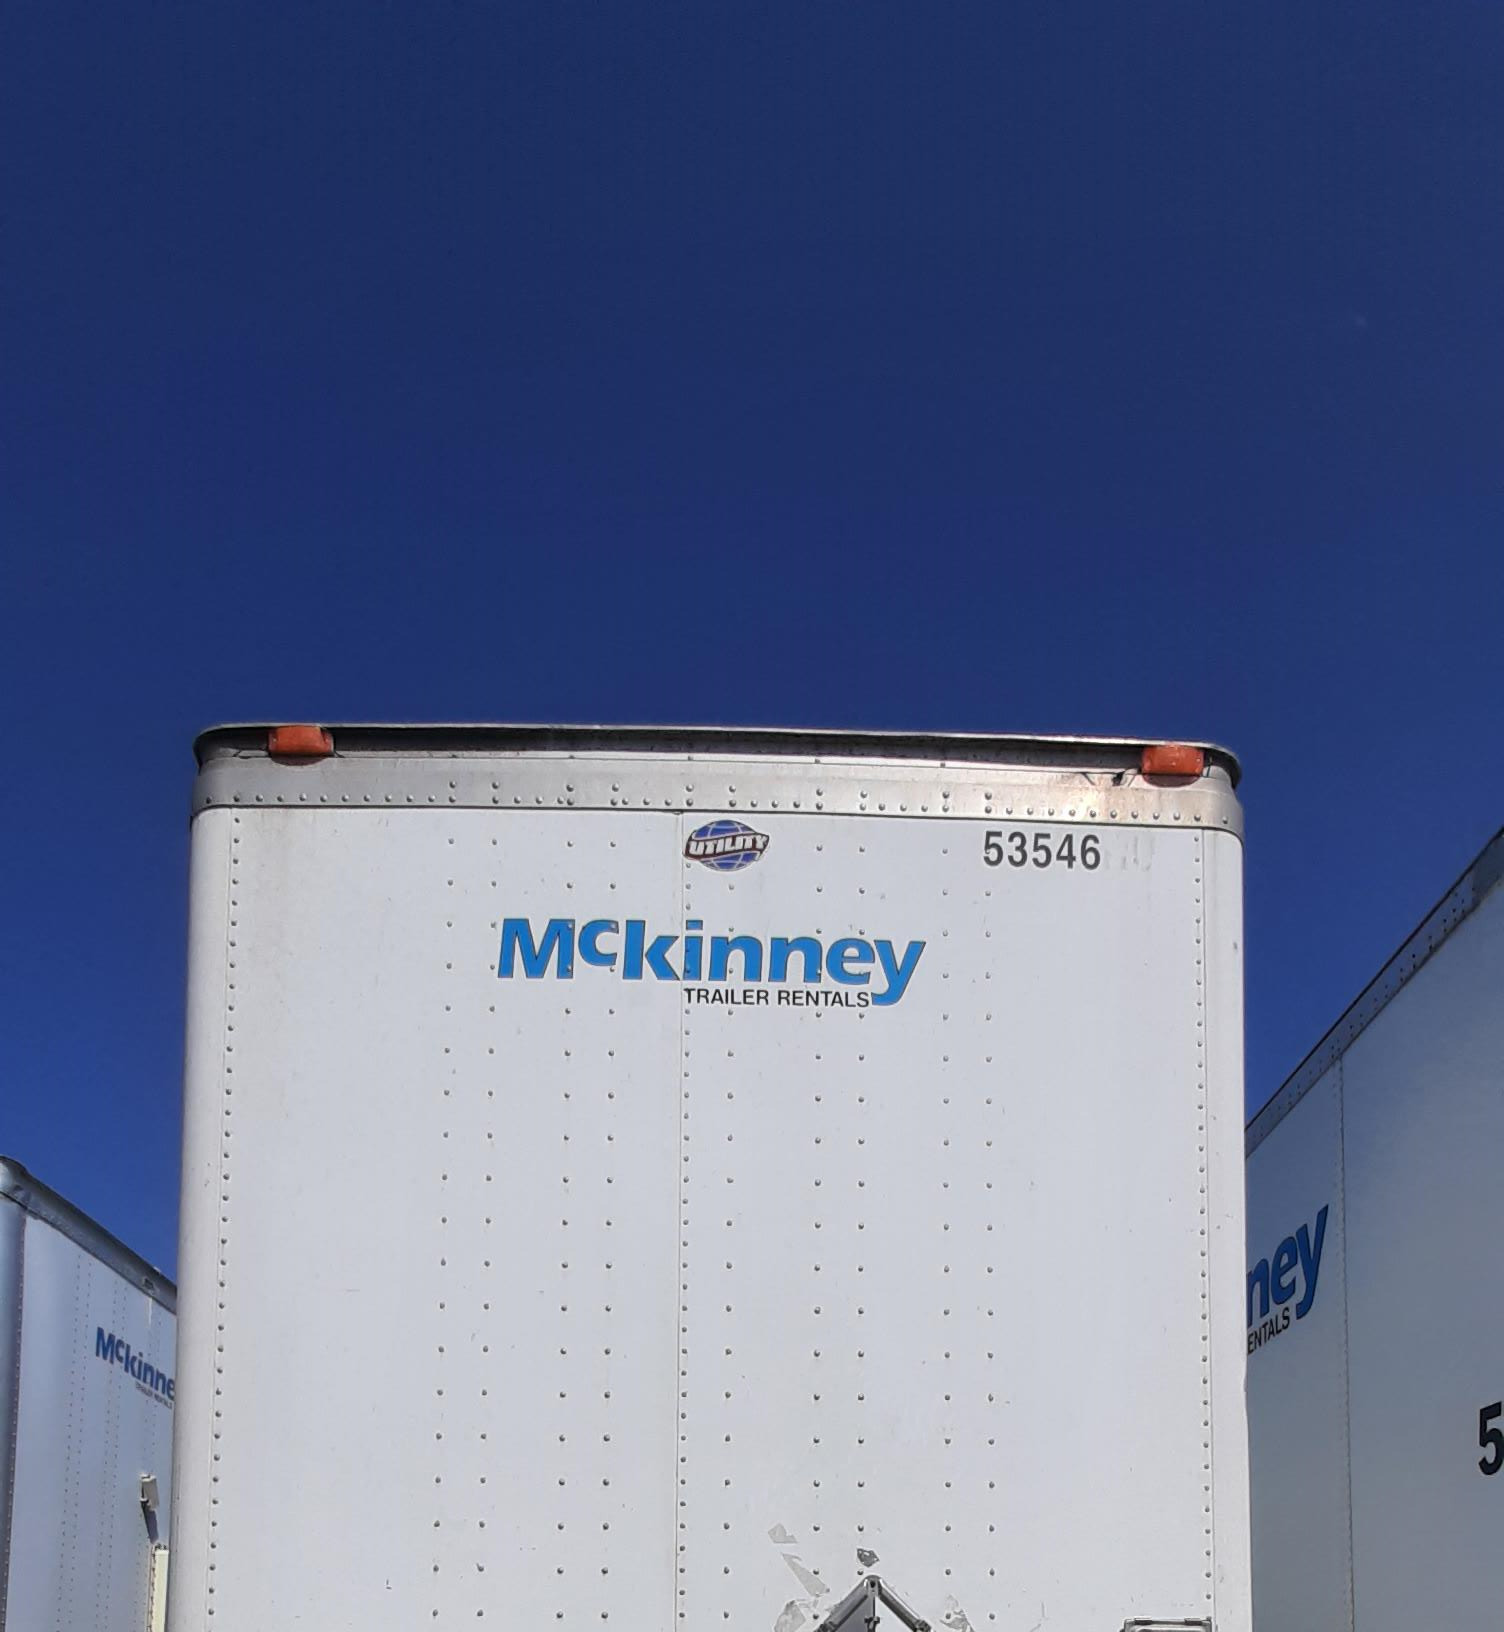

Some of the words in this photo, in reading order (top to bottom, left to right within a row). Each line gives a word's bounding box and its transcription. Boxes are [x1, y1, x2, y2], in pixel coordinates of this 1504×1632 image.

[689, 834, 768, 855] UTILITY
[983, 831, 1101, 870] 53546
[684, 988, 769, 1006] TRAILER
[778, 989, 870, 1008] RENTALS
